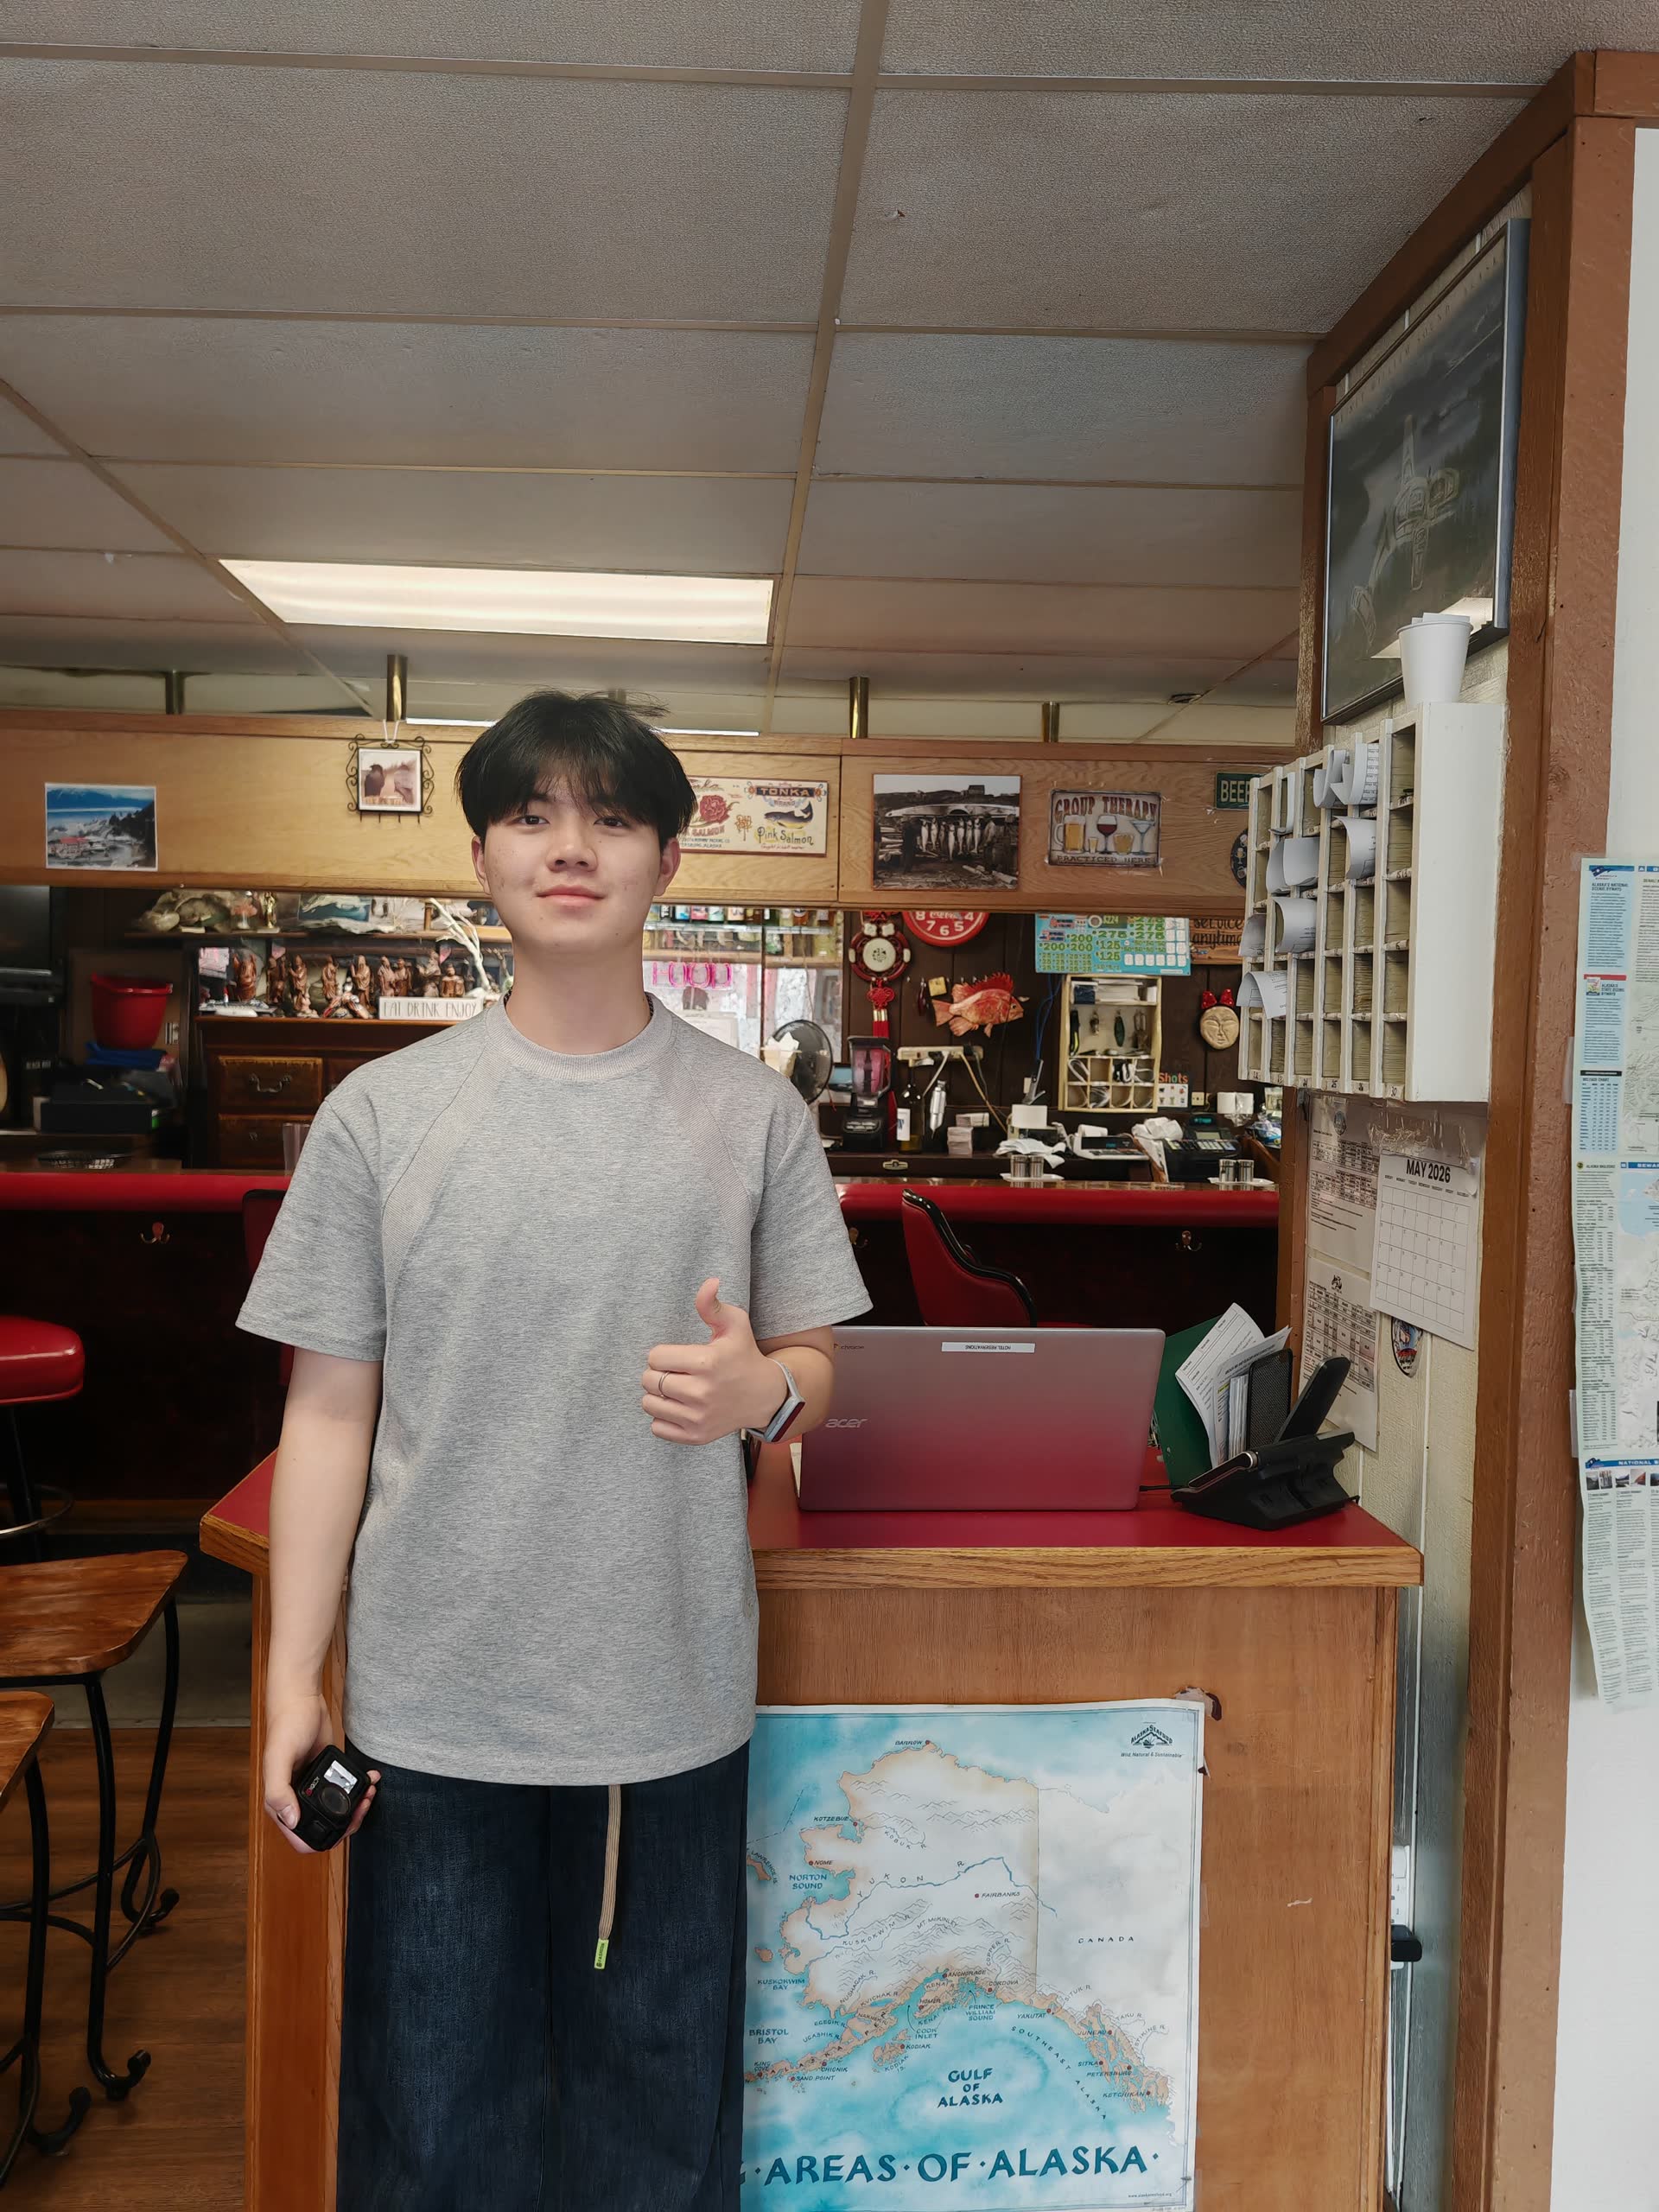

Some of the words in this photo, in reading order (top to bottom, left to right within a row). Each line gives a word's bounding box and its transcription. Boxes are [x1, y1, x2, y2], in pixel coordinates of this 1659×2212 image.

[760, 788, 810, 797] TONKA
[1054, 797, 1095, 823] GROUP
[1103, 797, 1157, 821] THERAPY
[757, 826, 779, 843] Pink
[780, 830, 814, 845] Salmon
[926, 920, 936, 931] 7
[939, 925, 950, 936] 6
[954, 921, 963, 931] 5
[407, 1002, 440, 1017] DRINK
[446, 1002, 477, 1018] ENJOY
[1159, 1072, 1188, 1084] Shots
[1406, 1159, 1427, 1178] MAY
[1428, 1163, 1451, 1183] 2026
[825, 1418, 868, 1428] acer
[1077, 1936, 1135, 1944] CANADA
[948, 1969, 986, 1978] ANCHORAGE
[860, 1993, 892, 2006] KVICHAK
[1011, 2025, 1071, 2070] SOUTHEAST
[885, 2056, 908, 2072] KODIAK
[948, 2068, 993, 2082] GULF
[963, 2083, 980, 2093] OF
[937, 2093, 1003, 2108] ALASKA
[765, 2154, 898, 2186] AREAS
[917, 2152, 972, 2183] OF
[988, 2145, 1147, 2179] ALASKA
